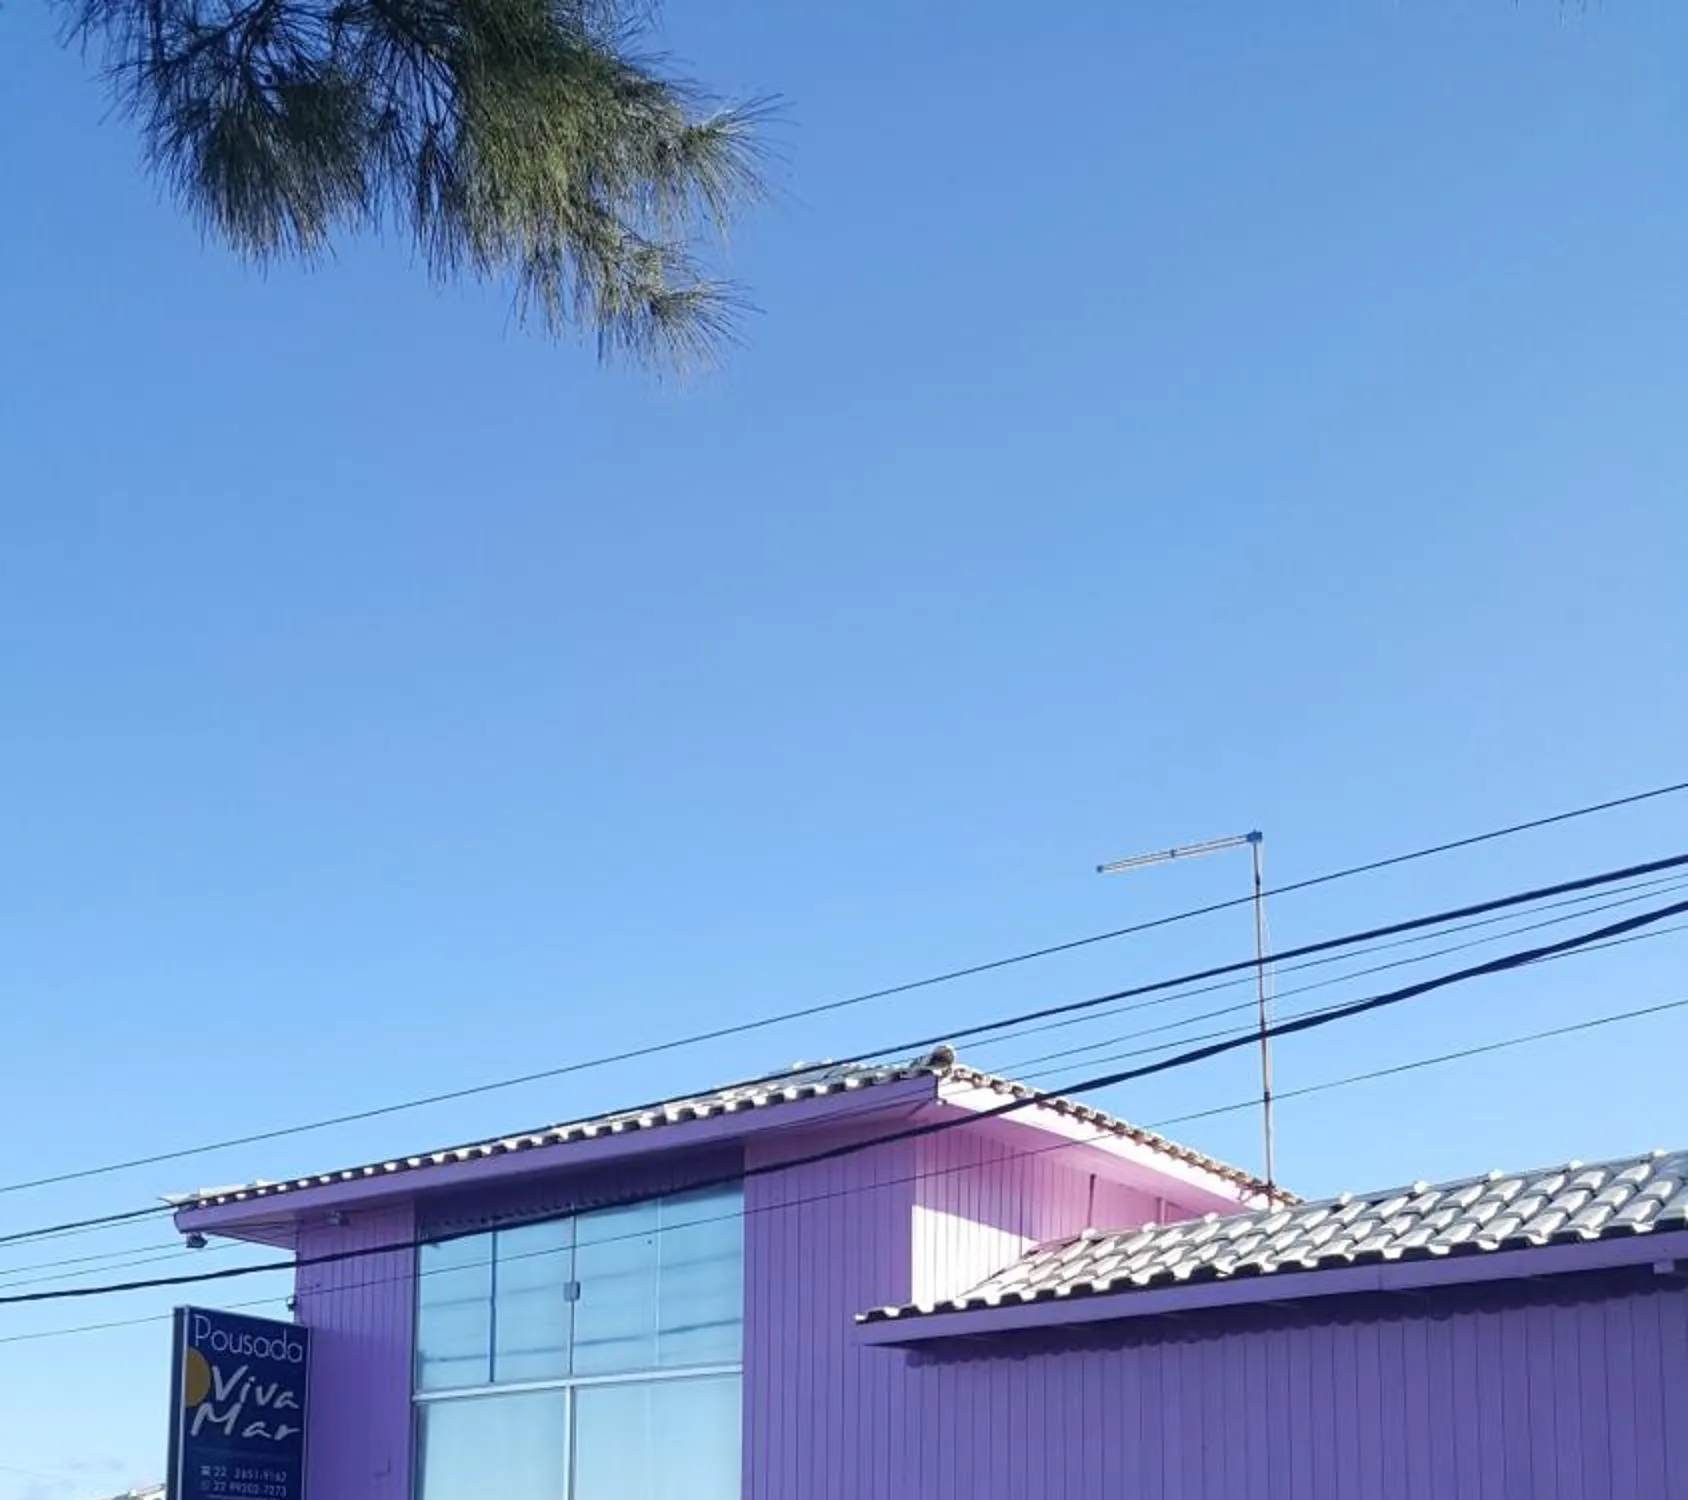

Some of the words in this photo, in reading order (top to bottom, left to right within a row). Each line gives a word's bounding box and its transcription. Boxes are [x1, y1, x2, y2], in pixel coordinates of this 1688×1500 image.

[193, 1314, 303, 1363] Pousada
[212, 1364, 300, 1408] Viva
[191, 1402, 300, 1440] Mar
